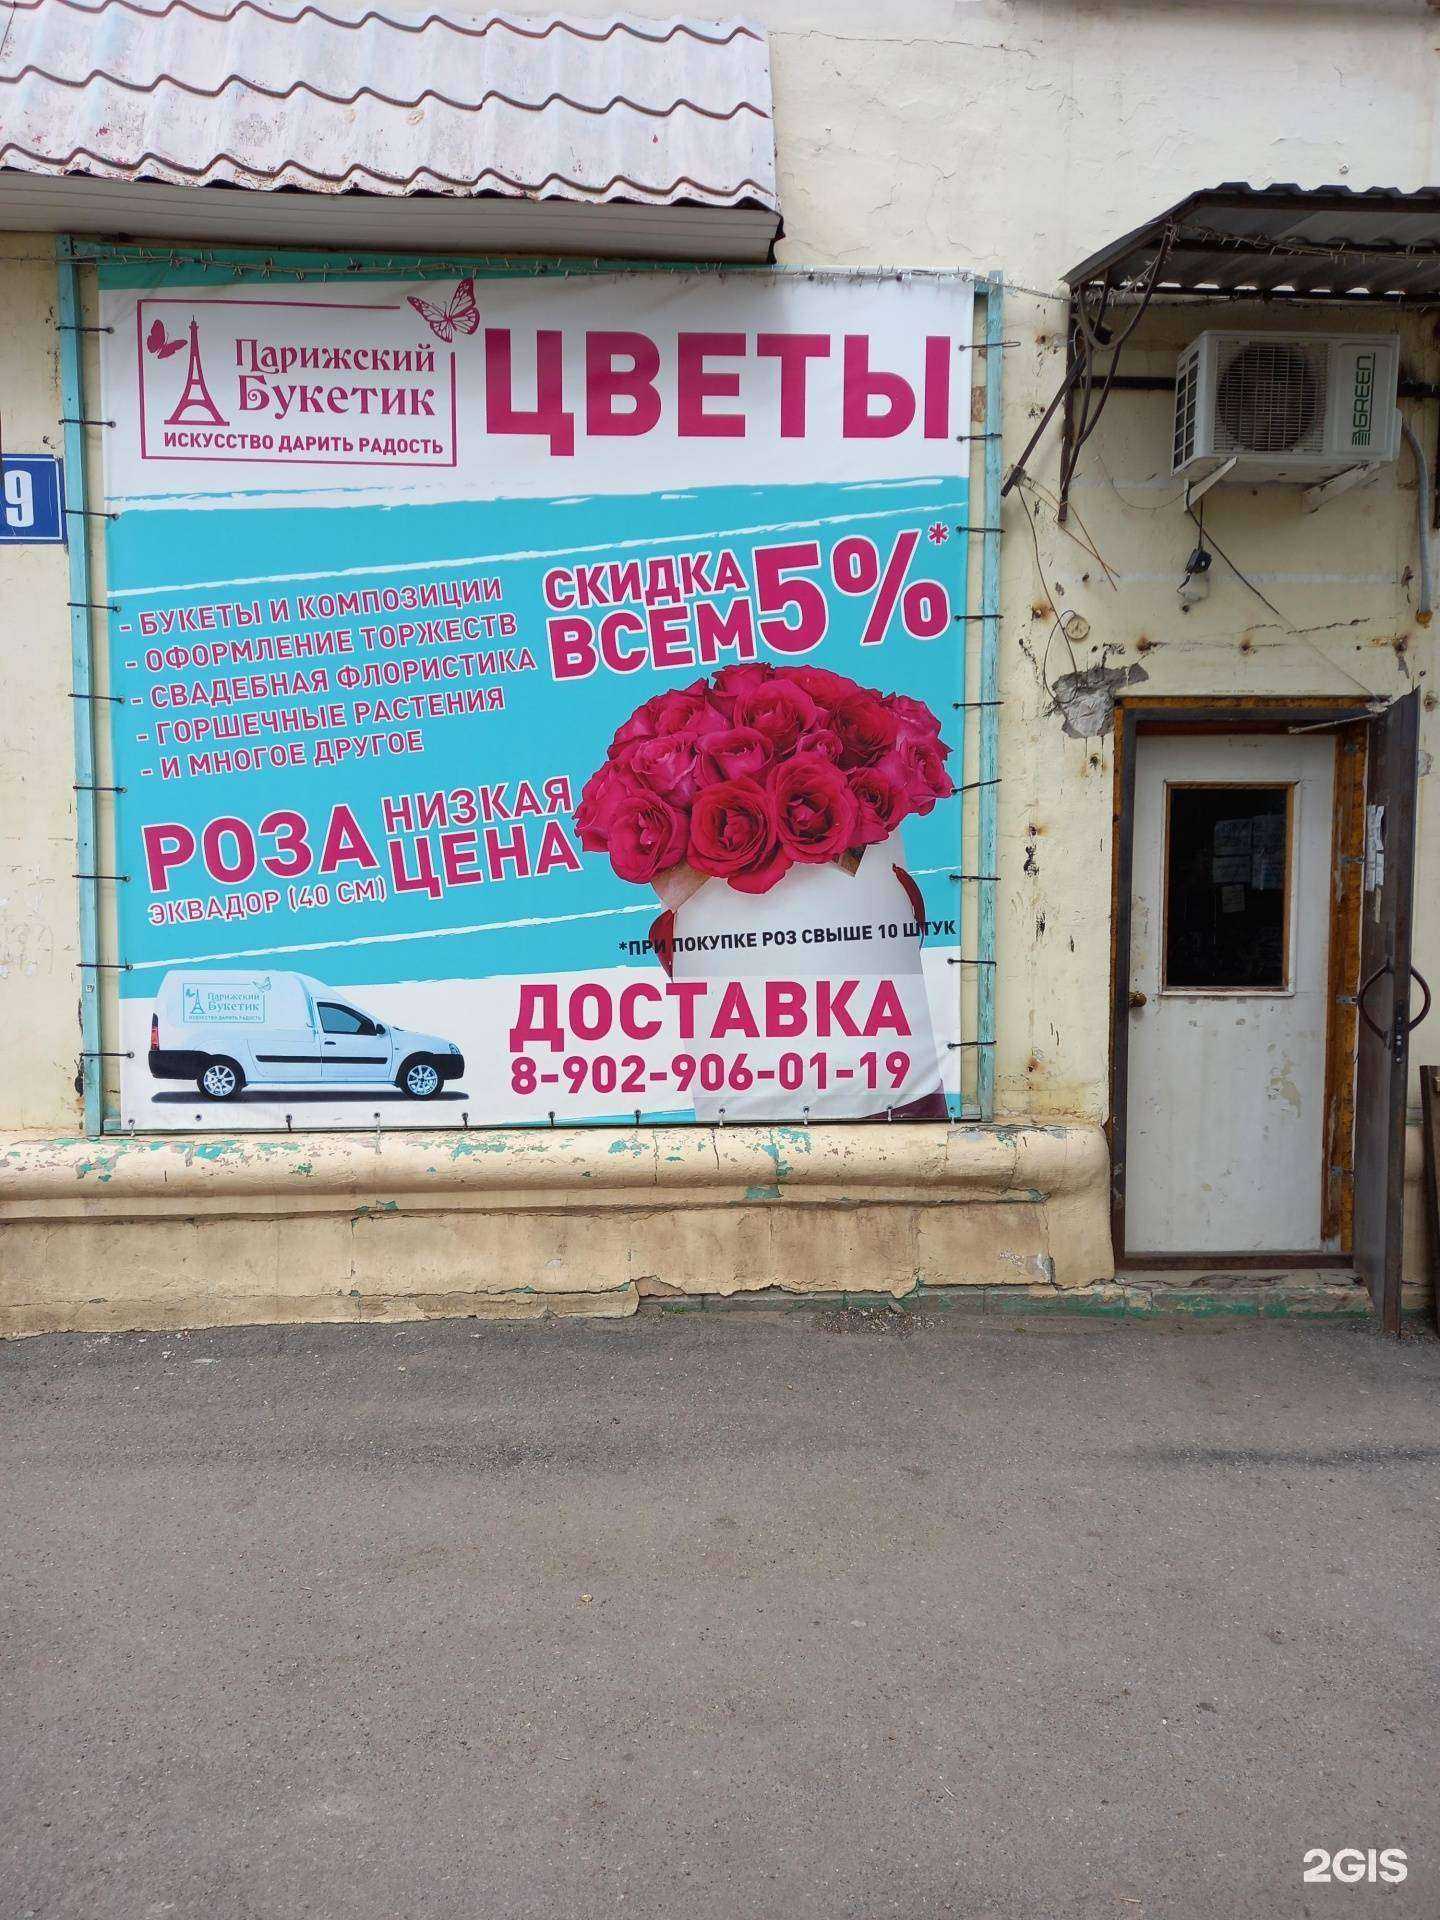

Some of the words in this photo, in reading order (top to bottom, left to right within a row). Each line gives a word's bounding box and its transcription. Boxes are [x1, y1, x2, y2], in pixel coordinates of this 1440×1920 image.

[235, 338, 435, 375] Парижский
[238, 375, 435, 420] Букетик
[484, 328, 951, 456] ЦВЕТЫ
[1353, 355, 1372, 428] GREEN
[164, 432, 274, 451] ИСКУССТВО
[278, 436, 353, 453] ДАРИТЬ
[359, 438, 444, 455] РАДОСТЬ
[4, 470, 34, 528] 9
[140, 601, 262, 637] БУКЕТЫ
[270, 598, 290, 622] И
[298, 577, 503, 621] КОМПОЗИЦИИ
[543, 549, 749, 610] СКИДКА
[145, 630, 354, 673] ОФОРМЛЕНИЕ
[360, 612, 518, 651] ТОРЖЕСТВ
[546, 598, 756, 681] ВСЕМ
[150, 668, 329, 709] СВАДЕБНАЯ
[336, 647, 537, 689] ФЛОРИСТИКА
[156, 704, 347, 745] ГОРШЕЧНЫЕ
[355, 686, 505, 725] РАСТЕНИЯ
[161, 756, 181, 780] И
[189, 737, 305, 777] МНОГОЕ
[313, 730, 424, 767] ДРУГОЕ
[381, 775, 574, 834] НИЗКАЯ
[141, 803, 380, 894] РОЗА
[387, 819, 583, 901] ЦЕНА
[146, 890, 280, 927] ЭКВАДОР
[288, 885, 330, 912] (40
[337, 876, 388, 905] СМ)
[672, 932, 757, 953] ПОКУПКЕ
[762, 930, 797, 946] РОЗ
[802, 924, 873, 944] СВЫШЕ
[878, 923, 898, 939] 10
[903, 920, 958, 938] ШТУК
[209, 1002, 259, 1011] Букетик
[509, 980, 912, 1053] ДОСТАВКА
[510, 1051, 911, 1096] 8-902-906-01-19
